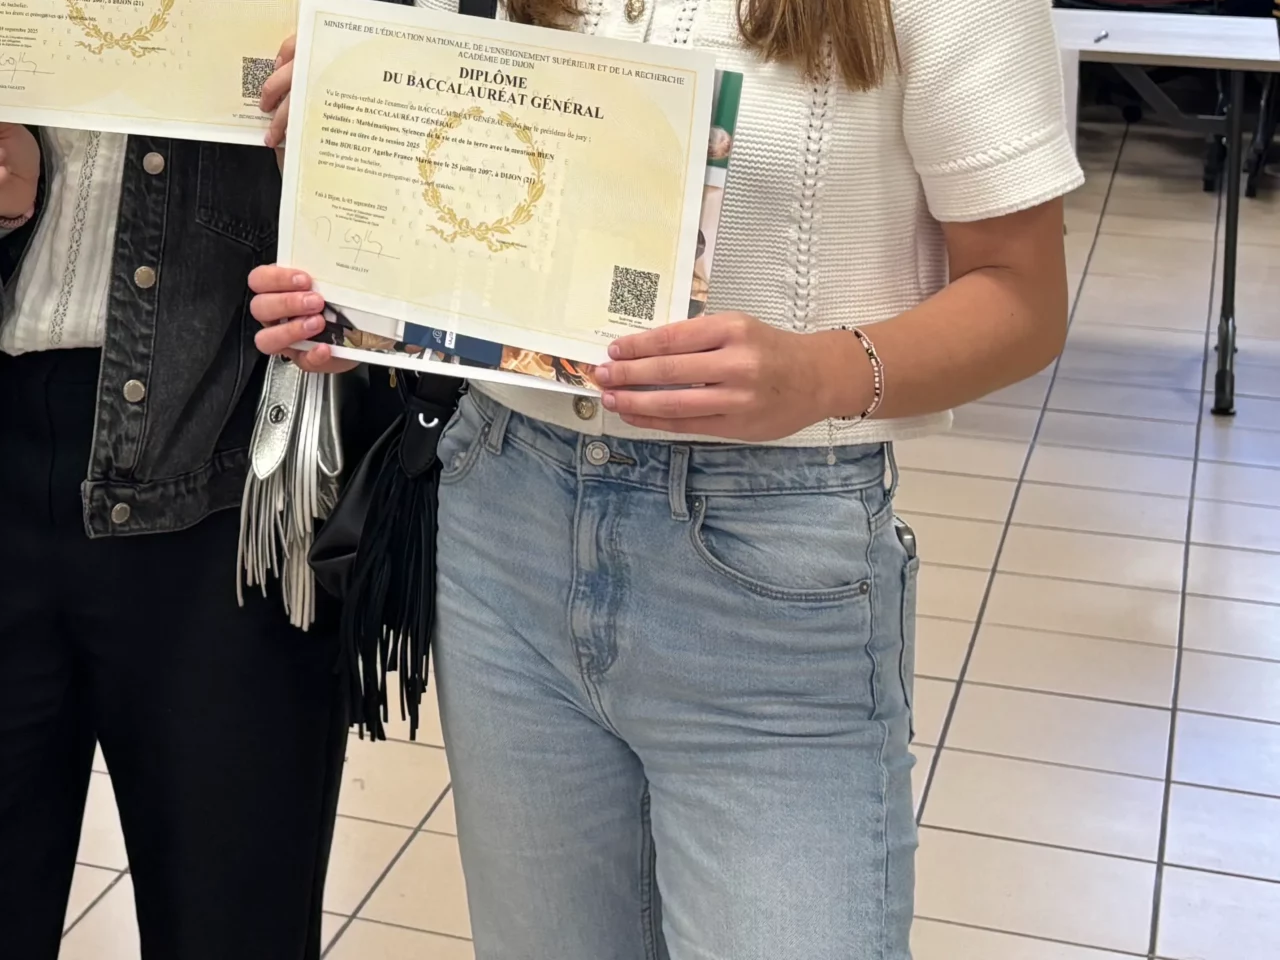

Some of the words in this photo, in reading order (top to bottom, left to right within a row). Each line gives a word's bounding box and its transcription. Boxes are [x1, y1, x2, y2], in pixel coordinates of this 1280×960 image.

[324, 20, 362, 31] MINISTÈRE
[375, 28, 424, 42] L'ÉDUCATION
[472, 43, 483, 51] DE
[484, 45, 549, 62] L'ENSEIGNEMENT
[551, 56, 595, 70] SUPÉRIEUR
[597, 64, 607, 72] ET
[609, 66, 620, 74] DE
[621, 68, 633, 76] LA
[634, 70, 684, 85] RECHERCHE
[458, 51, 498, 63] ACADÉMIE
[500, 57, 510, 65] DE
[511, 59, 534, 69] DIJON
[382, 70, 402, 84] DU
[406, 74, 527, 106] BACCALAURÉAT
[530, 95, 604, 119] GÉNÉRAL
[459, 65, 527, 88] DIPLÔME
